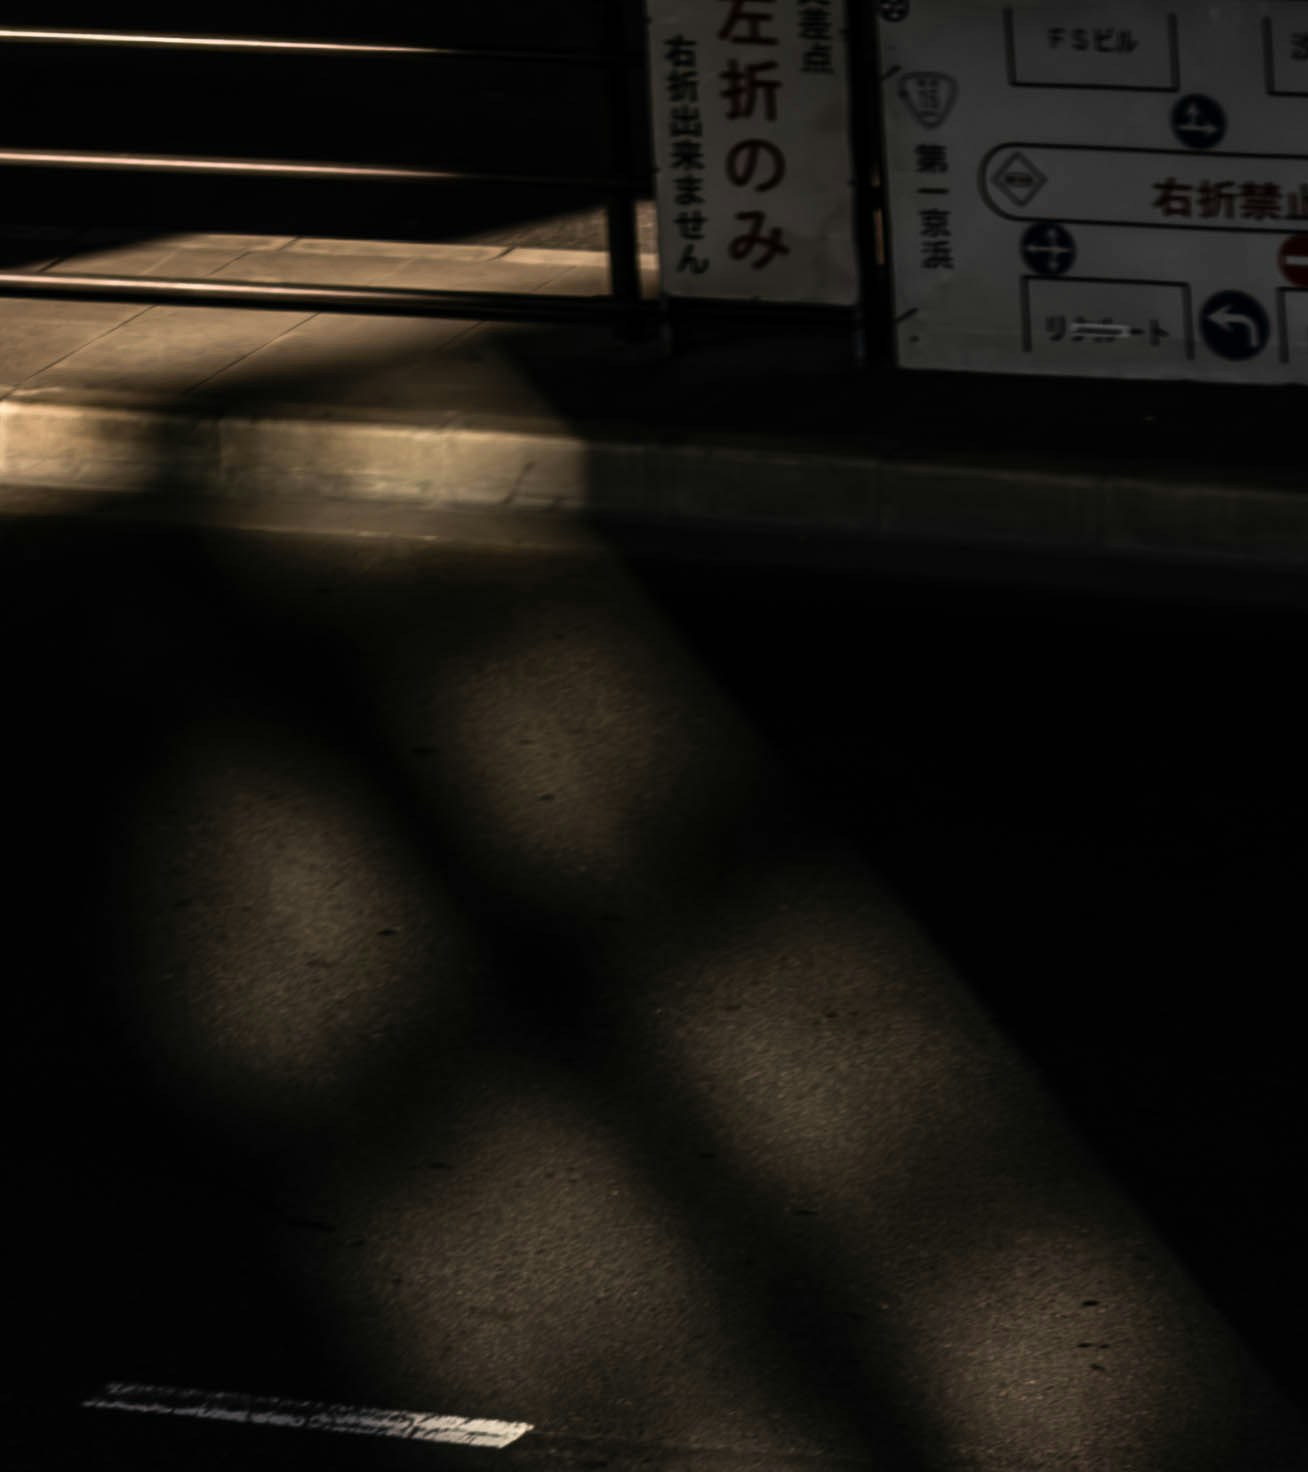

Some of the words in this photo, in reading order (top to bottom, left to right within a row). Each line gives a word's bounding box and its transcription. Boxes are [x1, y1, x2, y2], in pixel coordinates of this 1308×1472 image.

[664, 35, 709, 274] 右折出来ません
[717, 0, 791, 269] 左折のみ
[798, 0, 834, 74] 差点
